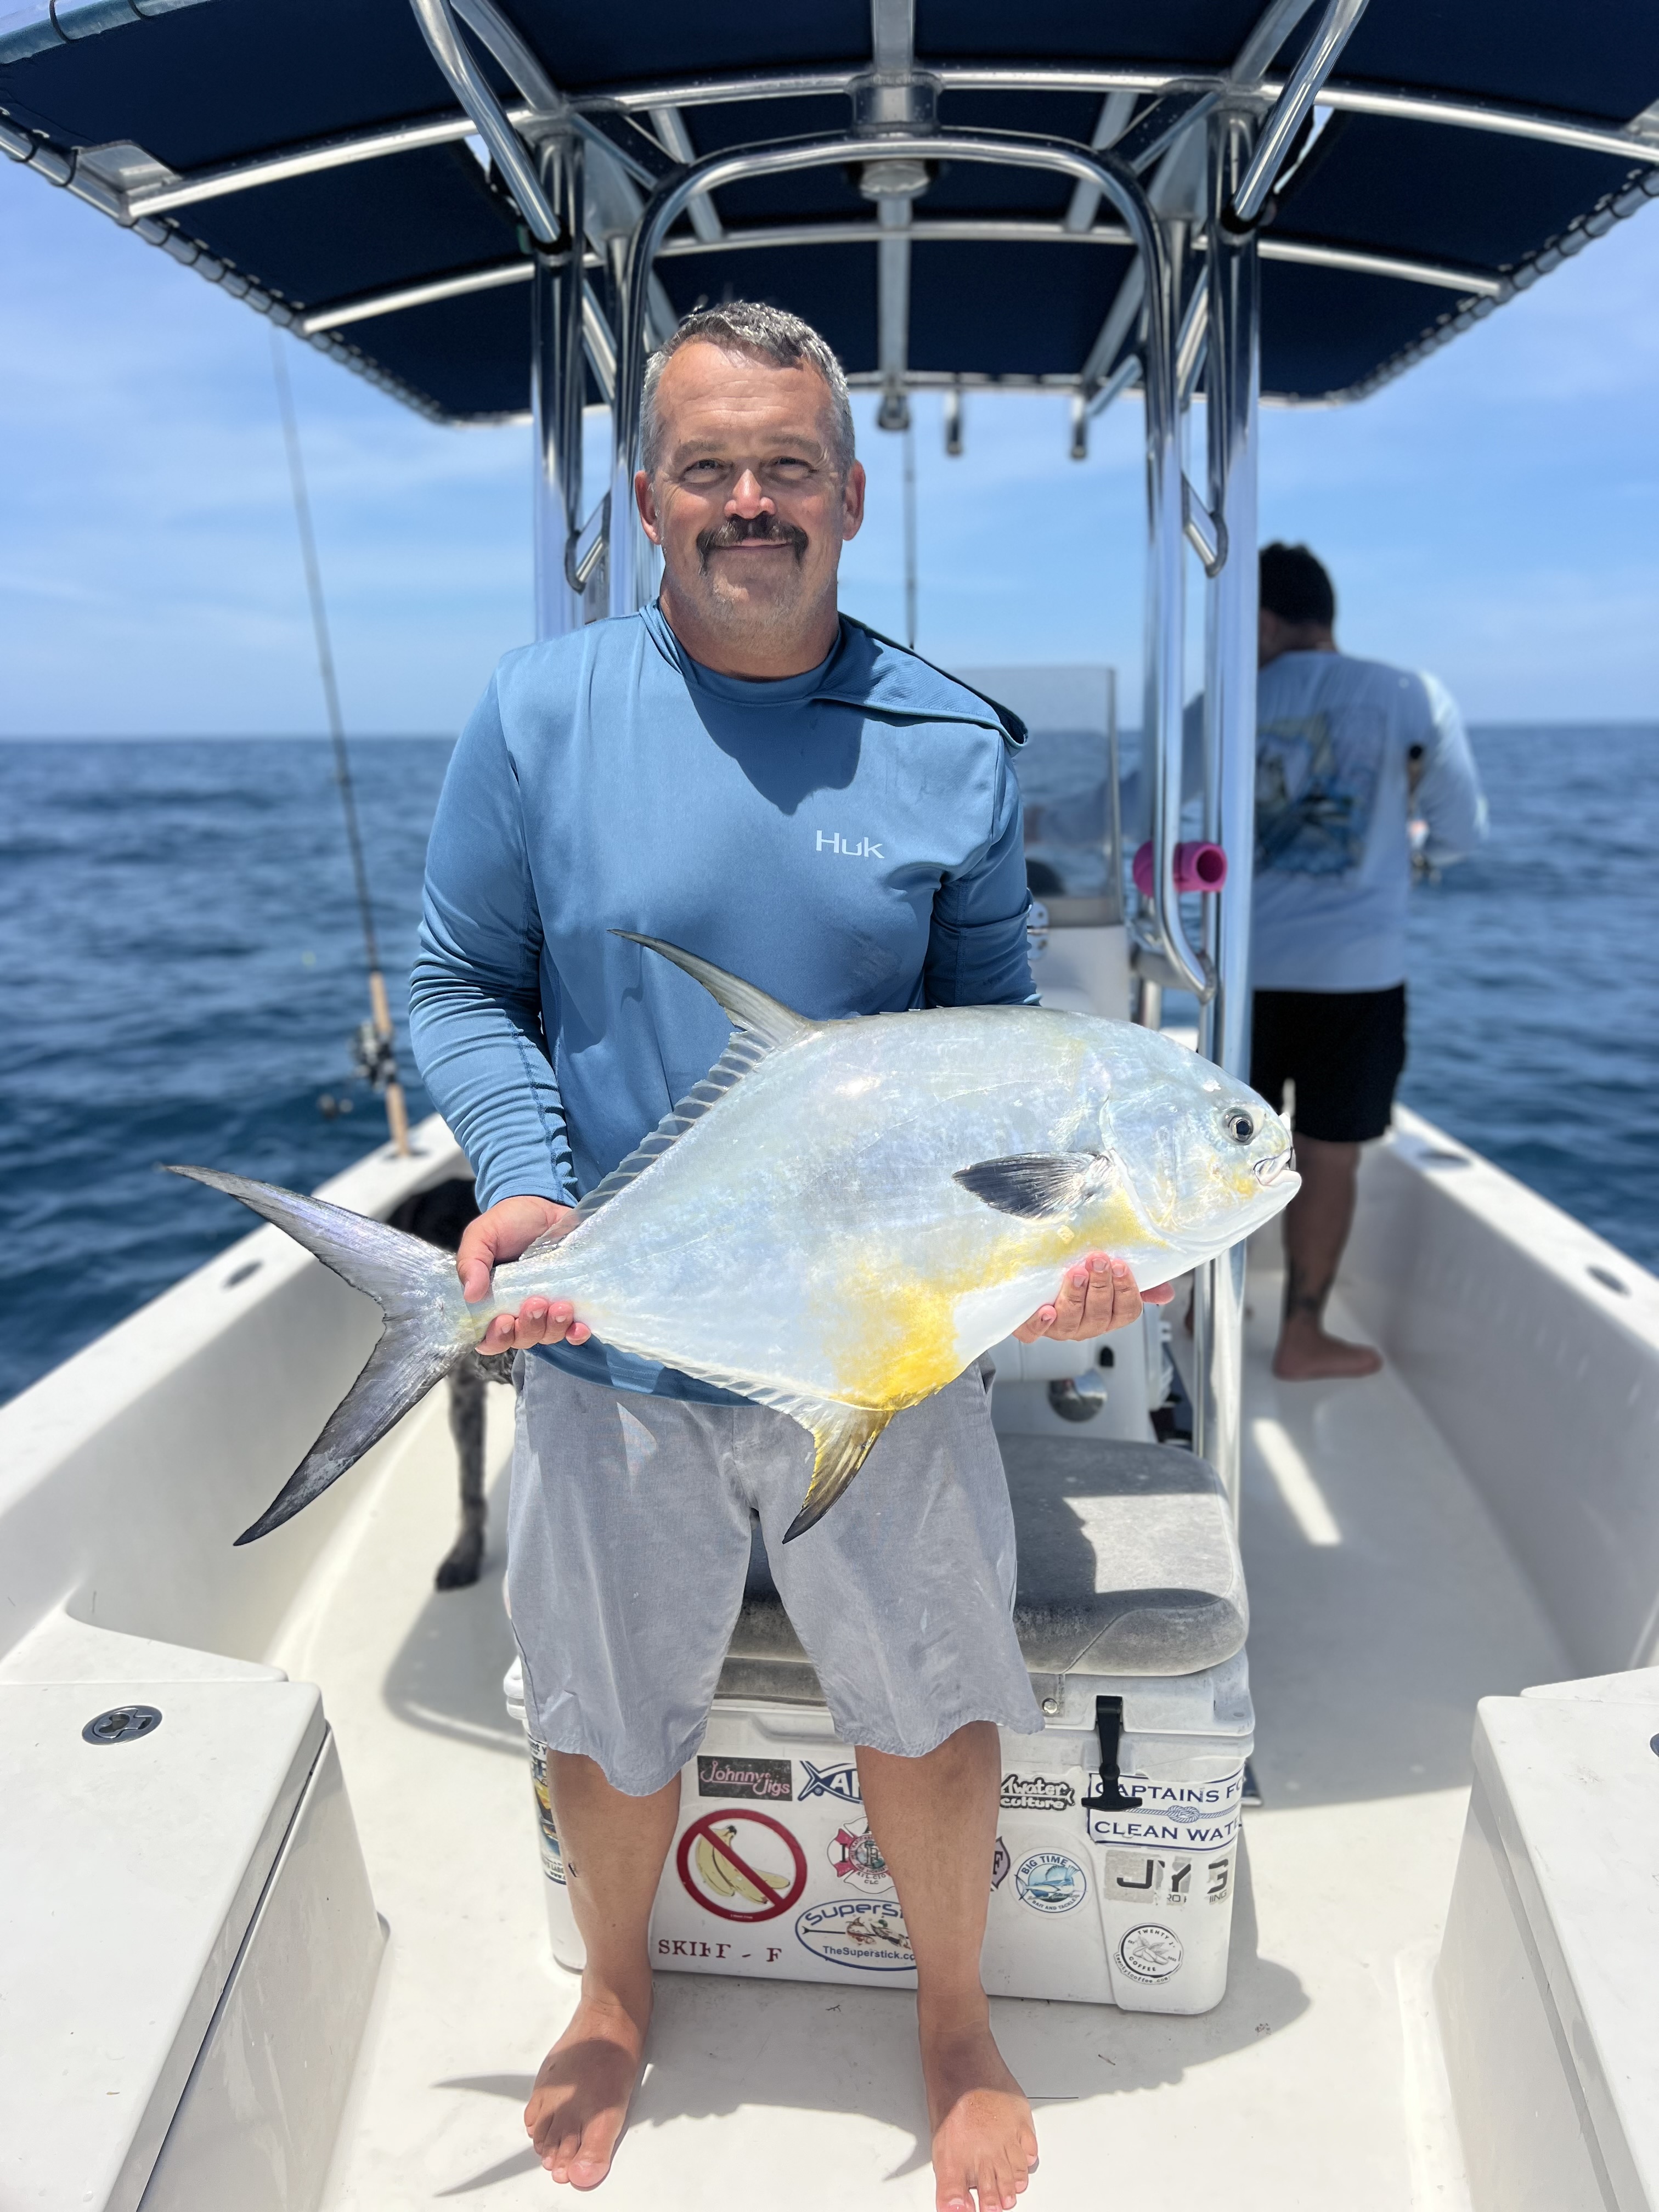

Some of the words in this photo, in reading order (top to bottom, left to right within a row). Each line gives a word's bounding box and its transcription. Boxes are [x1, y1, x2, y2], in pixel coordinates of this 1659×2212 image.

[752, 1772, 790, 1797] Jigs
[1000, 1797, 1065, 1809] culture
[1094, 1821, 1178, 1839] CLEAN
[1021, 1860, 1037, 1875] BIG
[1040, 1855, 1068, 1866] TIME
[1128, 1956, 1156, 1972] COFFEE
